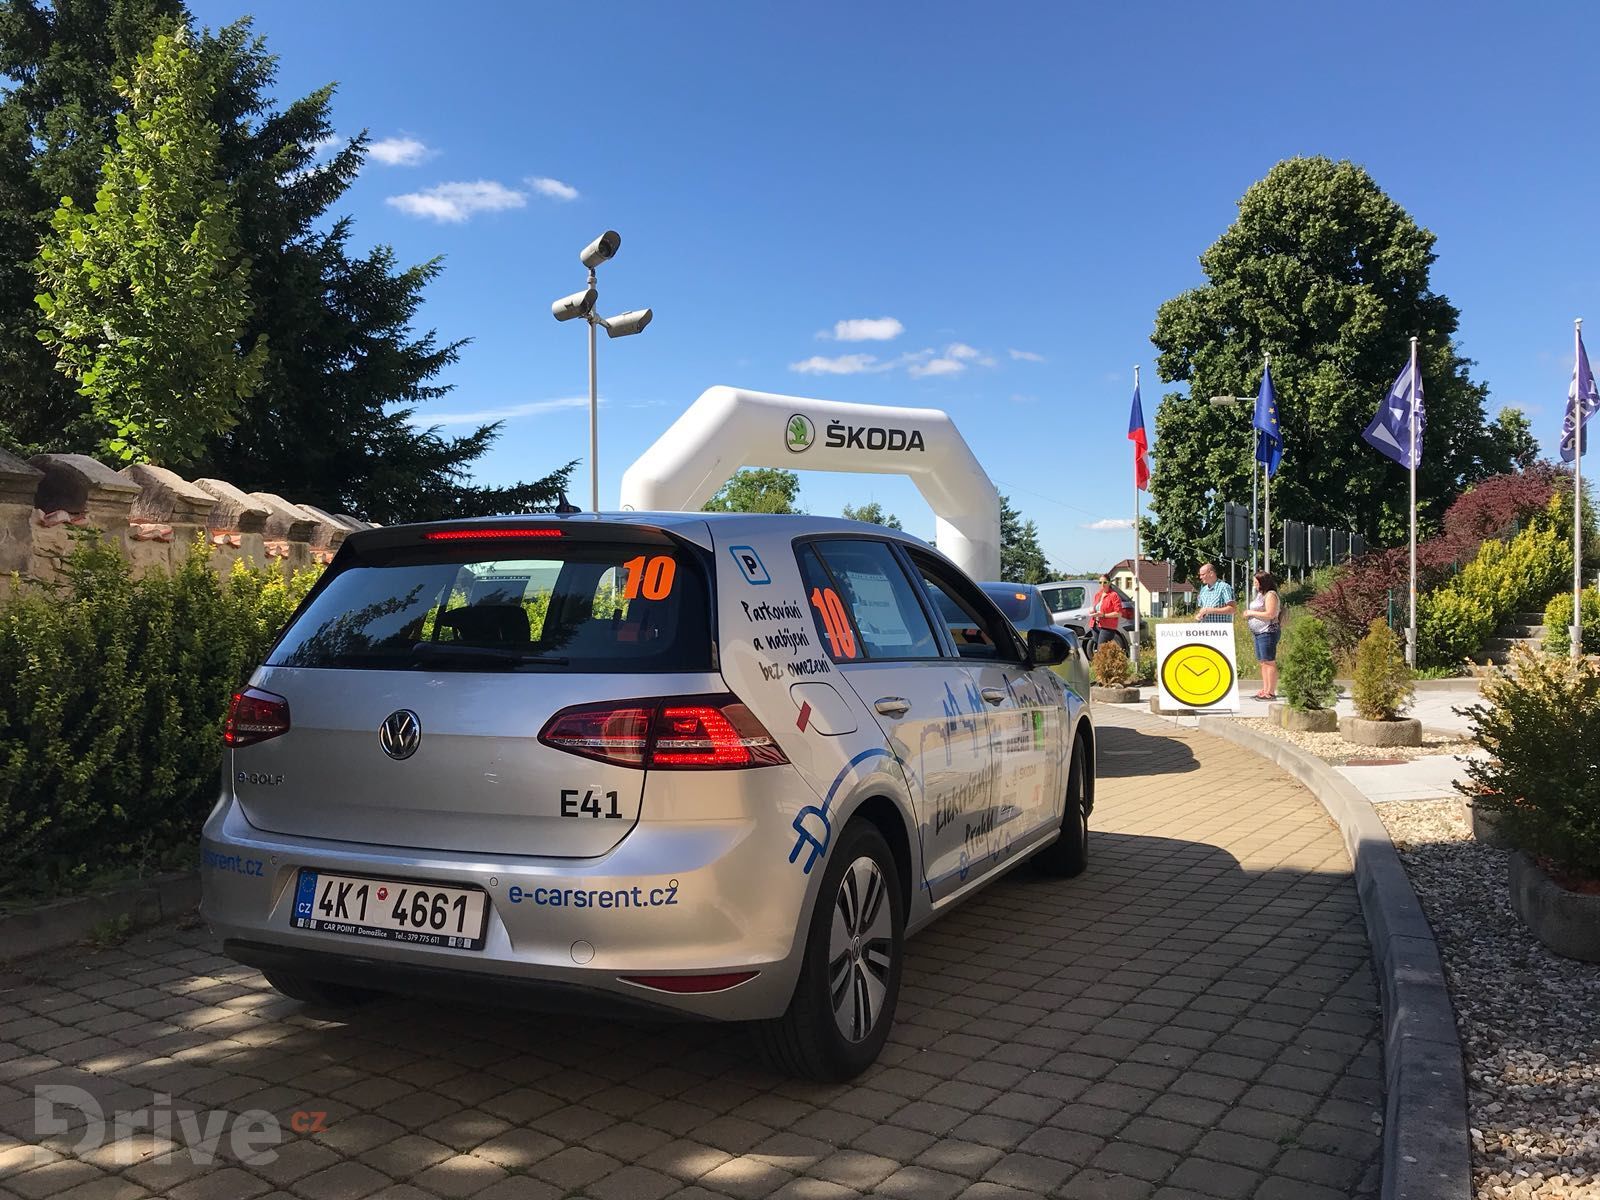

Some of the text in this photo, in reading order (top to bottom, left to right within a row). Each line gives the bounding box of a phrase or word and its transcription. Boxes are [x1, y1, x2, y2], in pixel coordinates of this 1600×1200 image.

[825, 419, 925, 452] ŠKODA
[622, 555, 676, 601] 10
[741, 555, 757, 574] P
[741, 600, 803, 622] Parkování
[810, 587, 856, 659] 10
[753, 638, 764, 651] a
[759, 653, 831, 681] bez omezení
[560, 789, 623, 819] E41
[298, 880, 468, 933] CZ 4K1 4661
[509, 885, 679, 908] e-carsrent.cz
[323, 922, 336, 932] CAR
[336, 924, 356, 934] POINT
[358, 927, 388, 938] Domažlice
[394, 932, 407, 941] Tel.:
[407, 933, 418, 941] 379
[419, 935, 429, 943] 775
